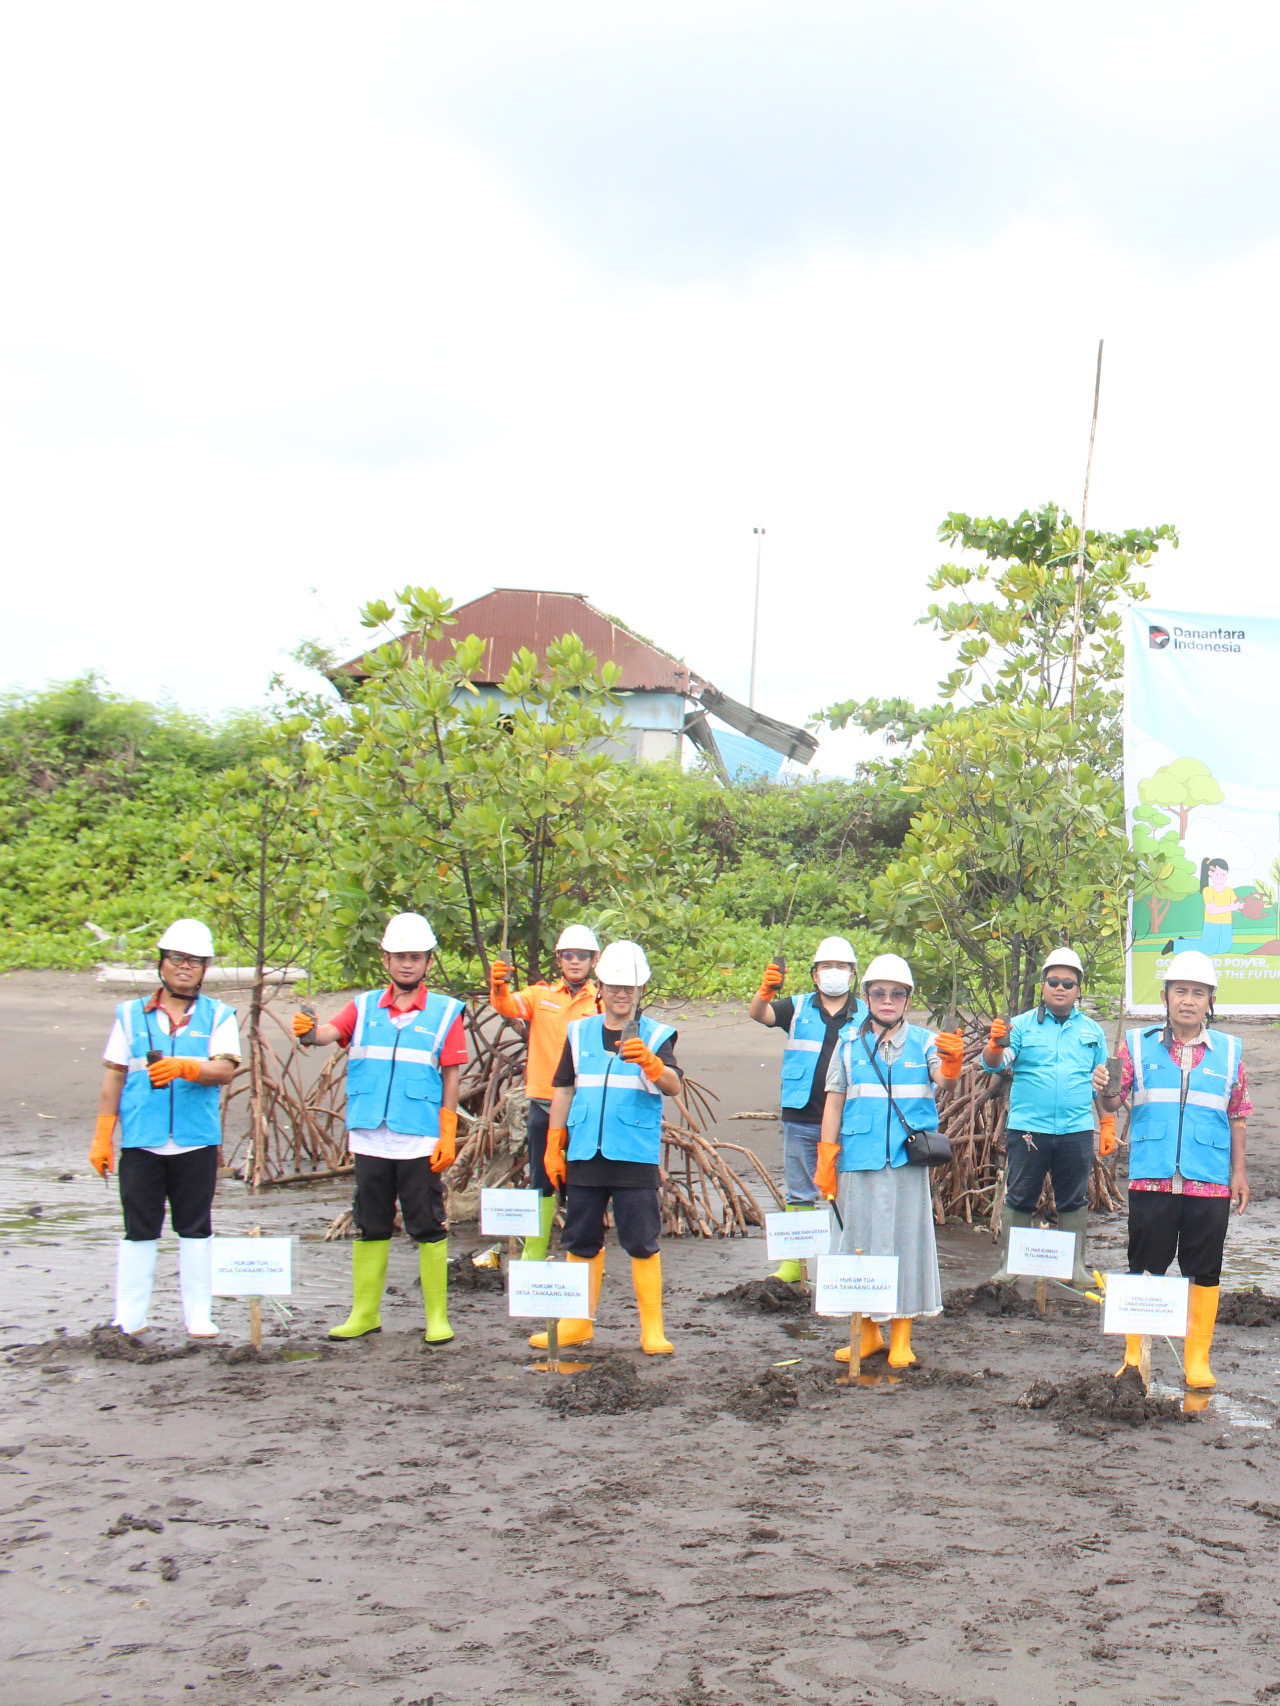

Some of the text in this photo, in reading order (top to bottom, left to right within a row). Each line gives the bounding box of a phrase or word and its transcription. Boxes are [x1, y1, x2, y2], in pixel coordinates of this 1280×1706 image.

[1173, 626, 1245, 640] Danantara
[1174, 638, 1241, 653] Indonesia
[1225, 958, 1270, 969] POWER,
[1225, 970, 1245, 979] THE
